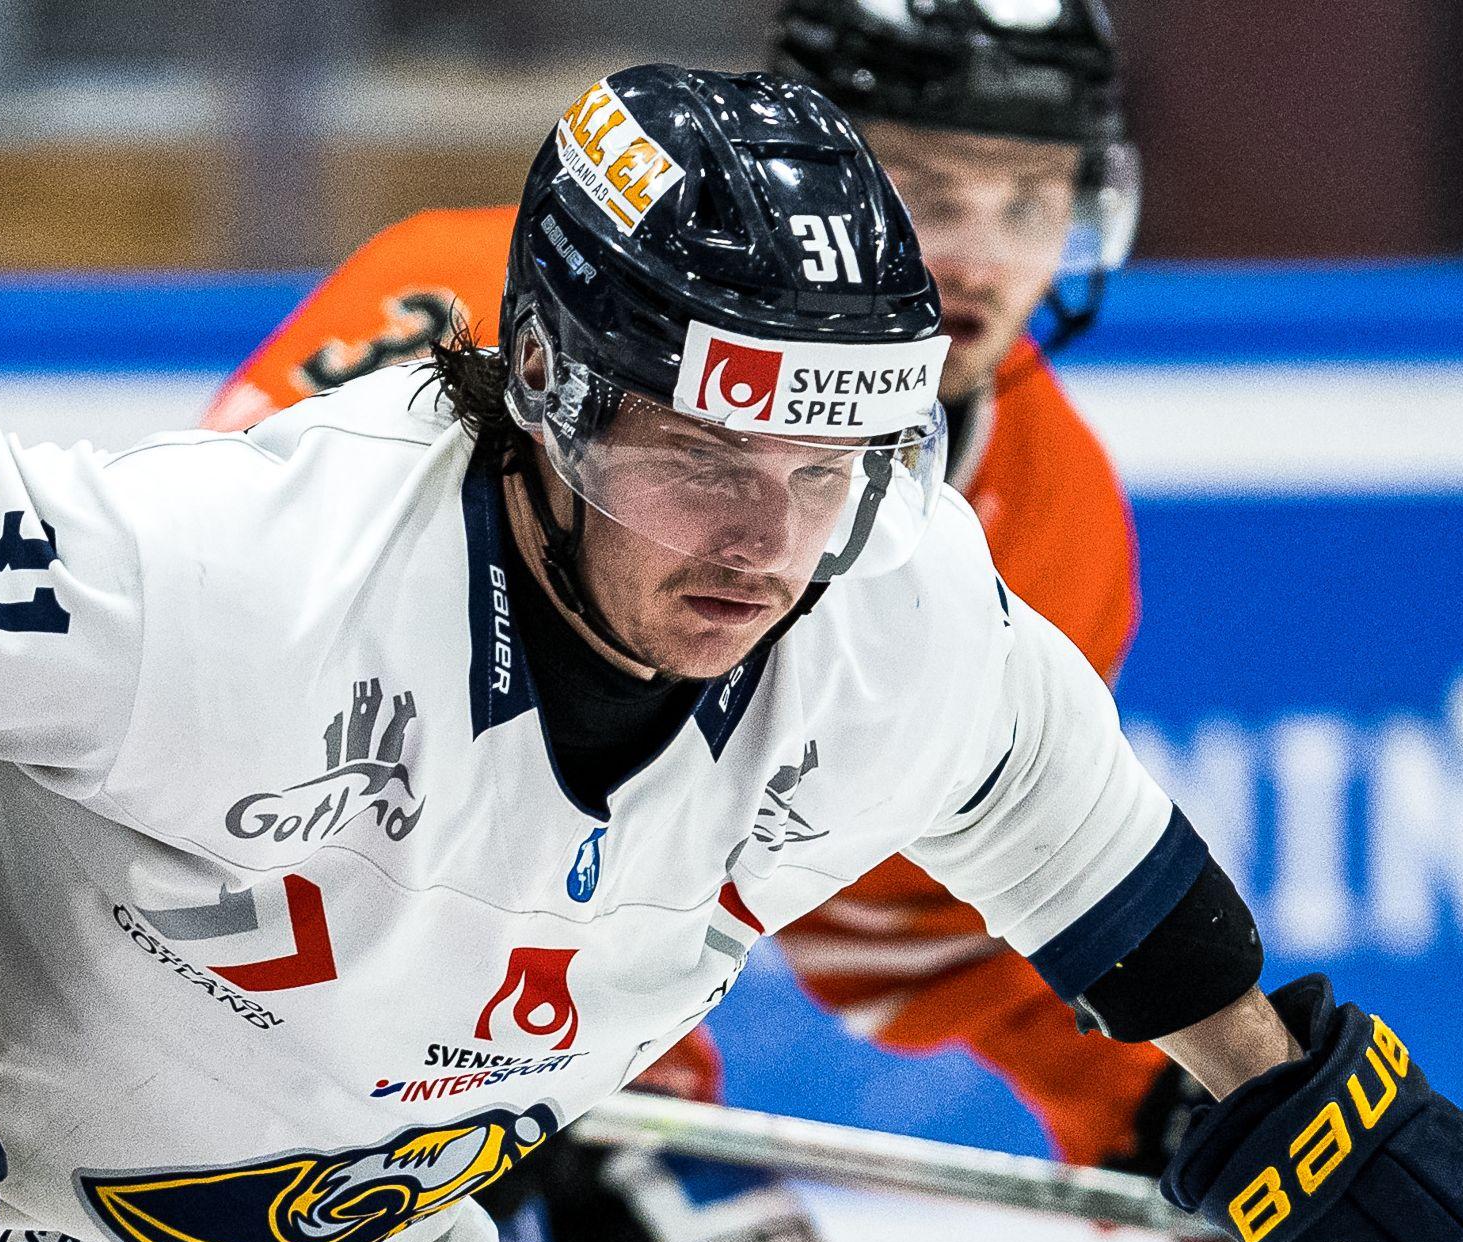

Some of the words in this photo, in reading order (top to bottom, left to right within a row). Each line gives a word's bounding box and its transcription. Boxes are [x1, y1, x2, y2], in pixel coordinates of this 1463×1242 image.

[540, 213, 598, 285] BAUER
[789, 213, 863, 284] 31
[784, 399, 864, 427] SPEL
[789, 364, 928, 395] SVENSKA
[488, 564, 512, 696] BAUER
[112, 903, 271, 1030] GOTLAND
